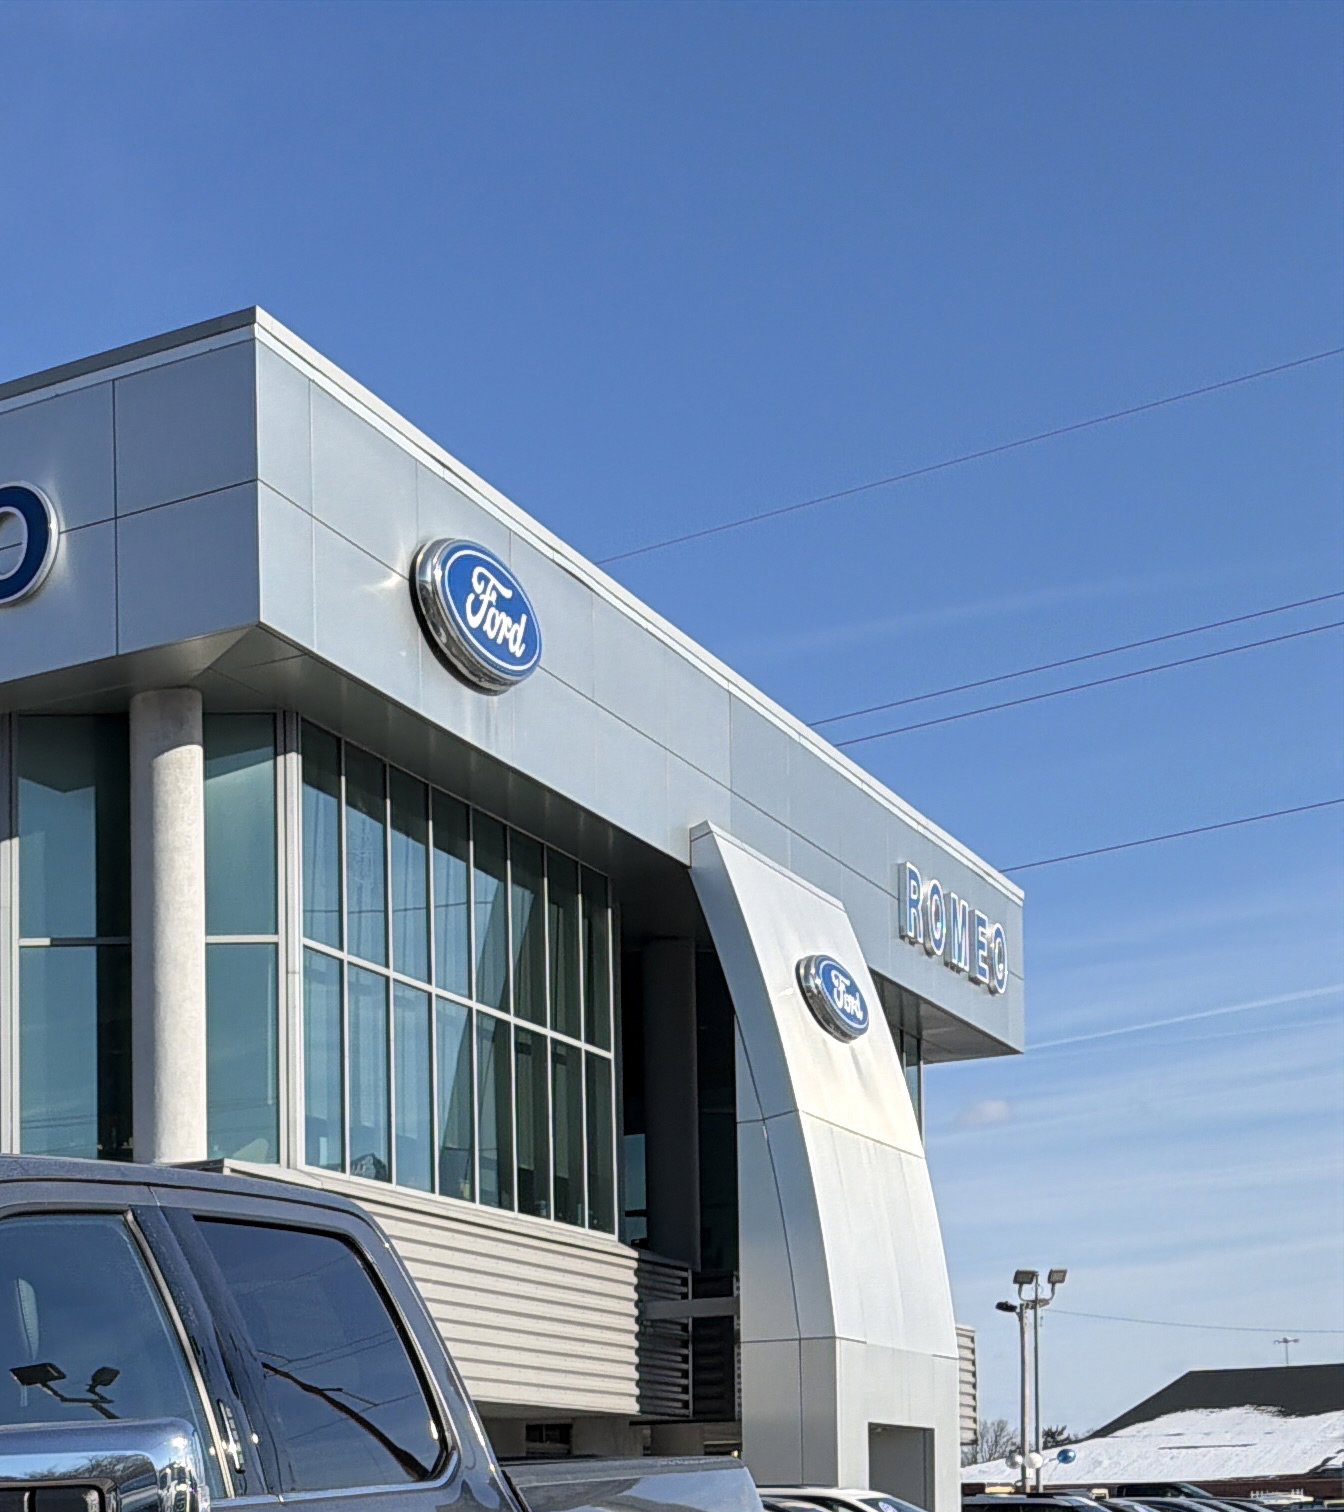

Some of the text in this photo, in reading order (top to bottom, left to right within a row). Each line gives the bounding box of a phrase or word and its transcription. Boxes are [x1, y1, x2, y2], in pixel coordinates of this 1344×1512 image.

[466, 566, 527, 657] Ford
[902, 861, 1008, 994] ROMEO
[831, 970, 863, 1020] Ford
